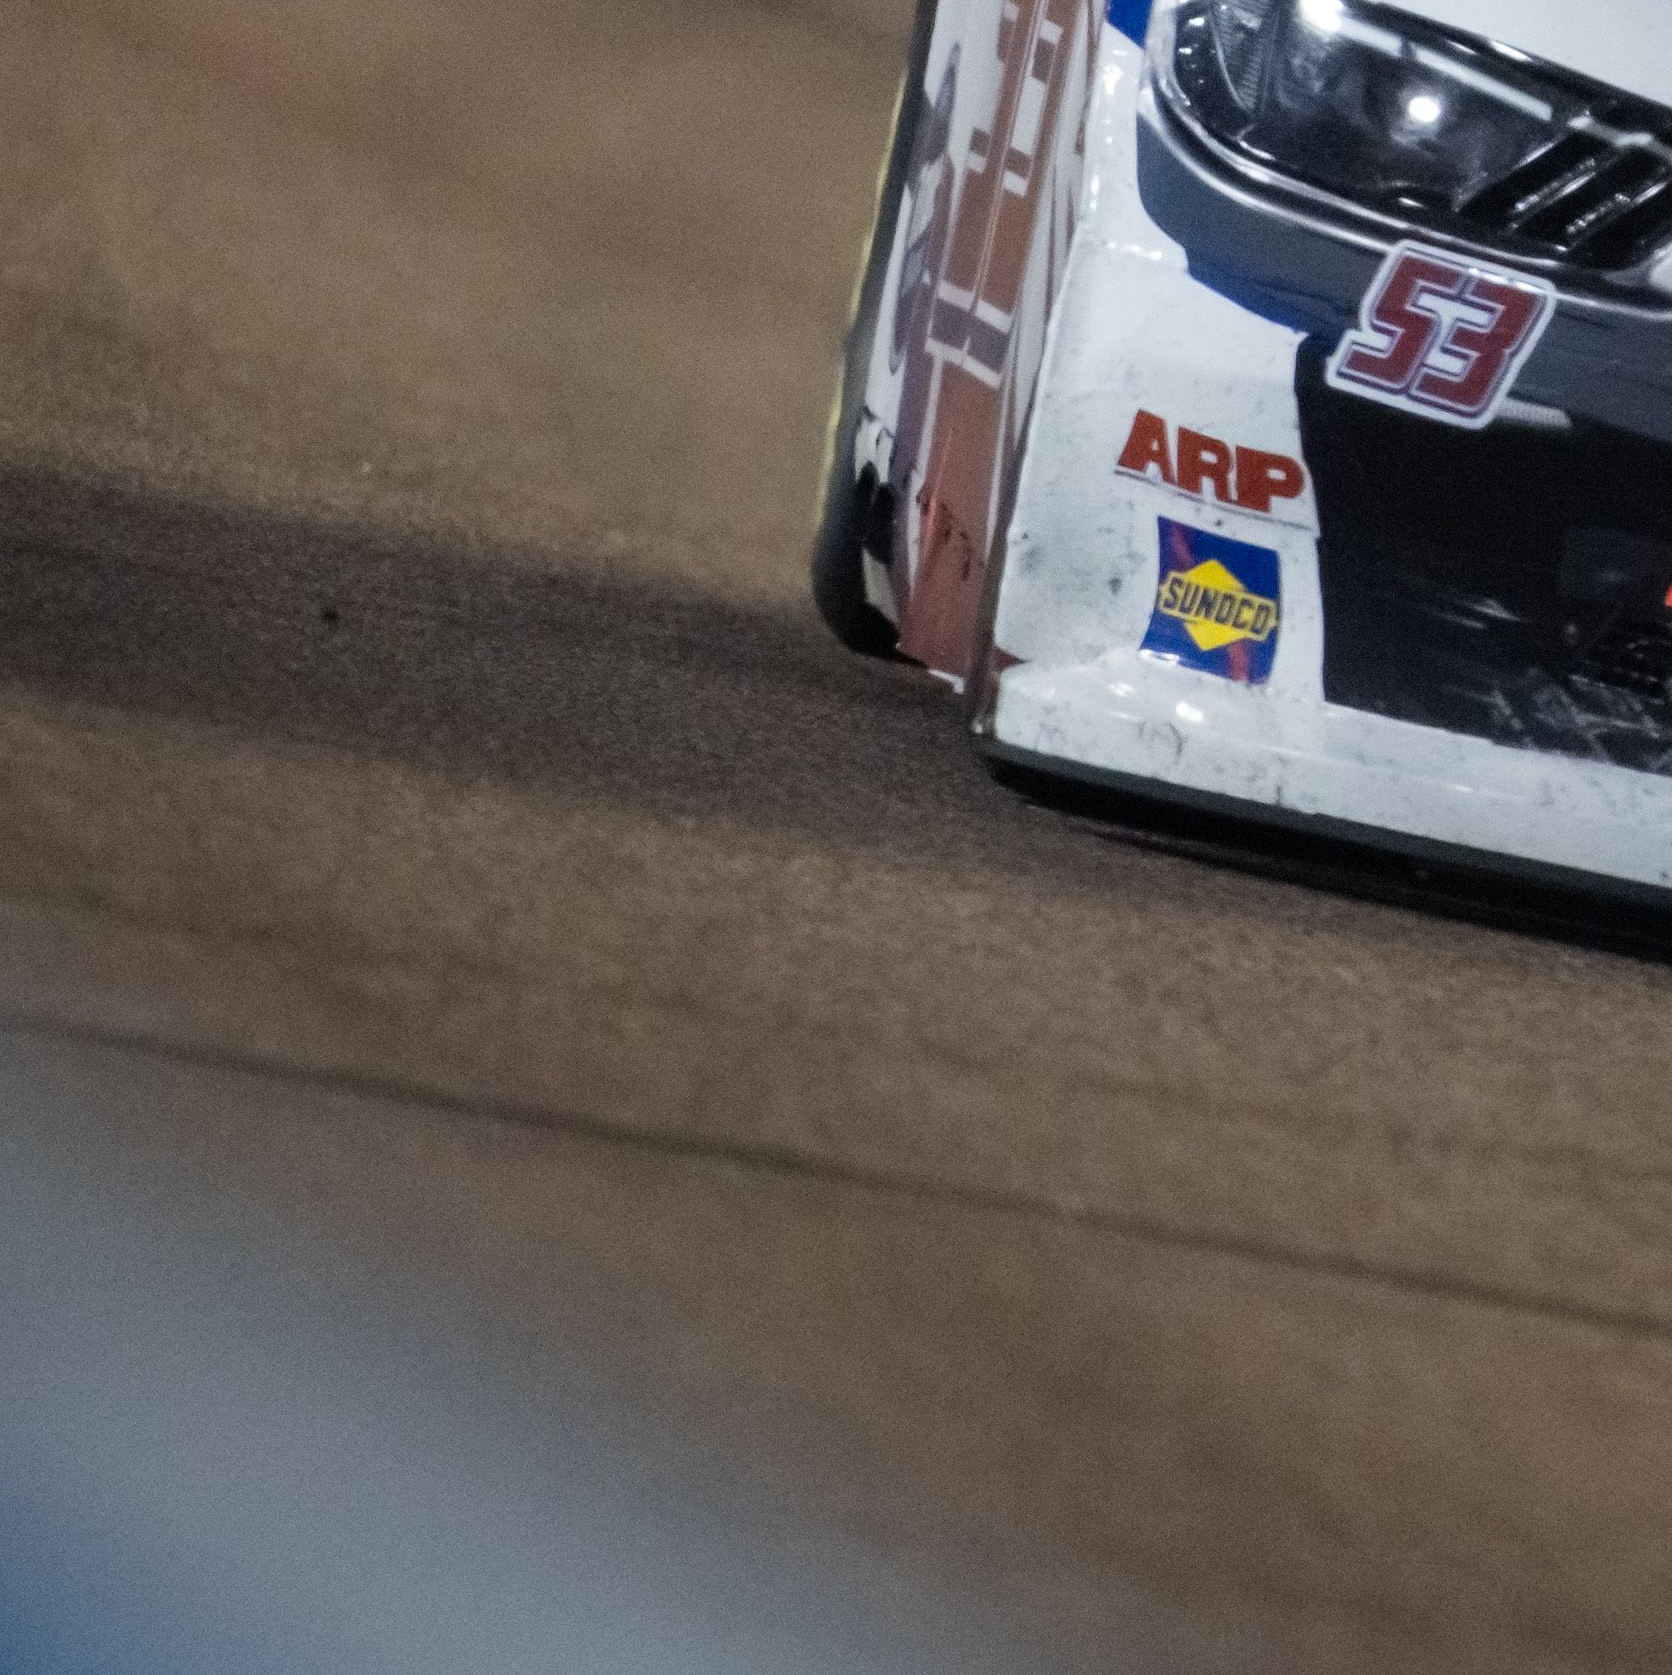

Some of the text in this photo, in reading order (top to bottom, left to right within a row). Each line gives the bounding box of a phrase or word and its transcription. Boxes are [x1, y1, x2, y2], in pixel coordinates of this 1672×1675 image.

[1333, 245, 1551, 423] 53
[1116, 408, 1305, 514] ARP
[1162, 576, 1275, 637] SUNOCO
